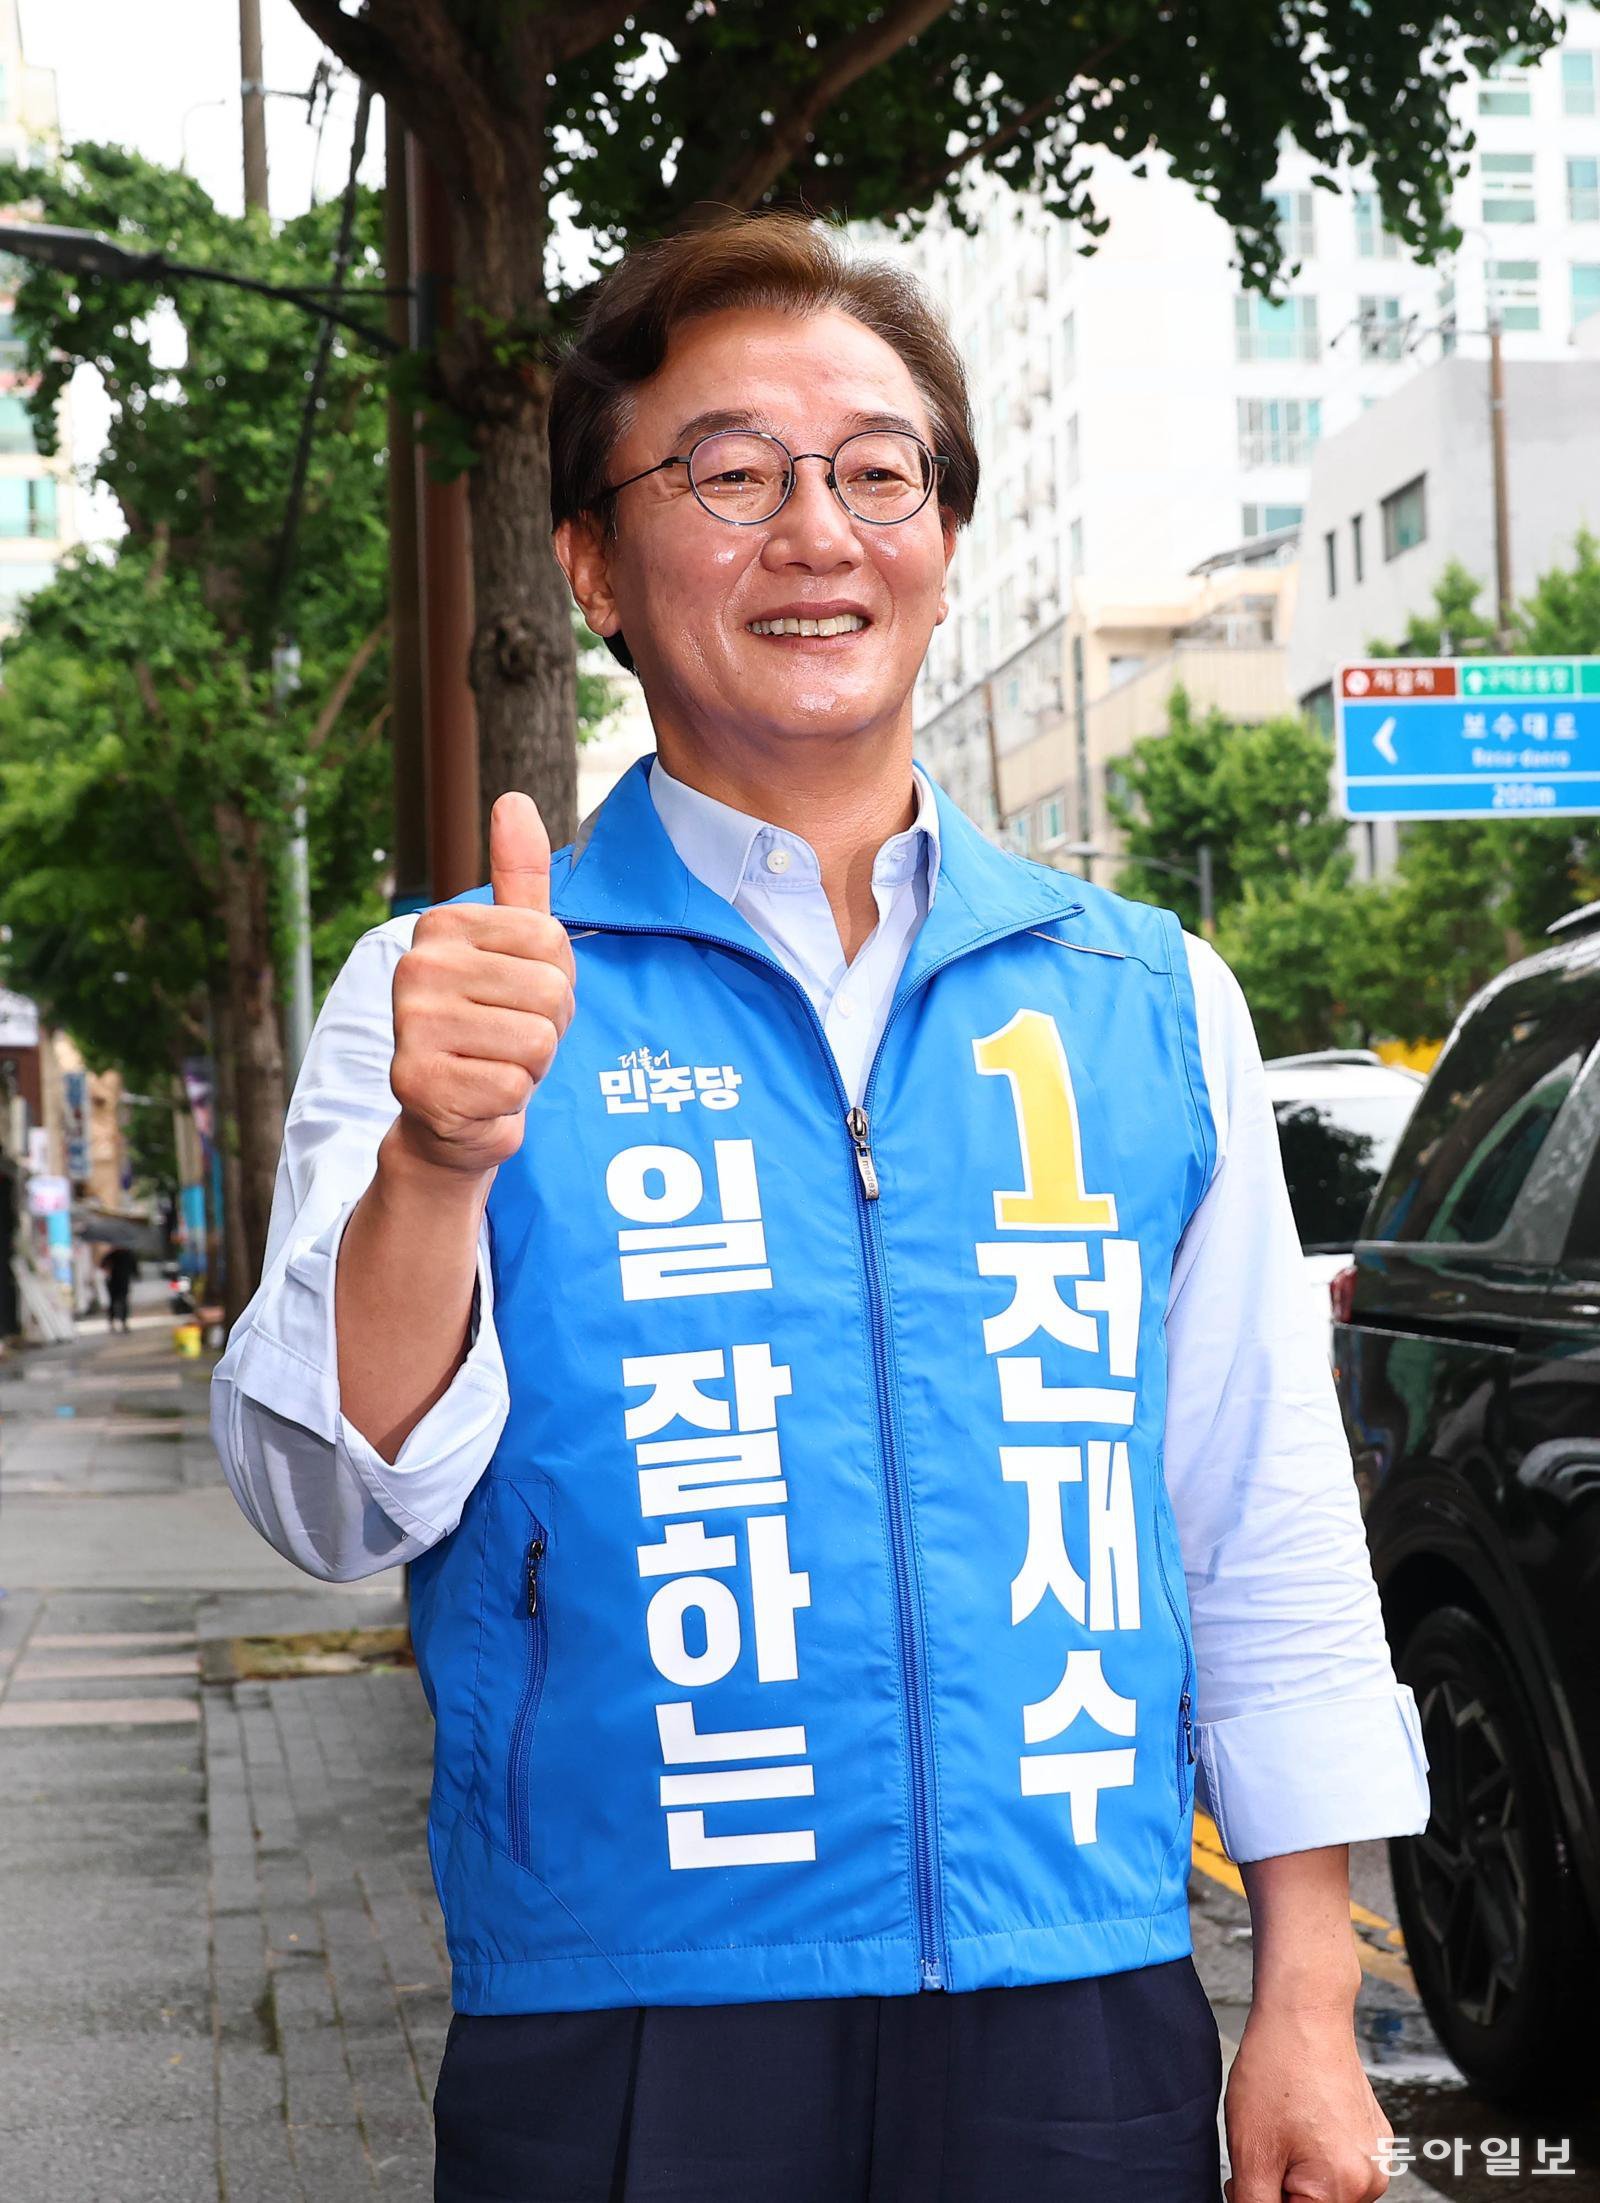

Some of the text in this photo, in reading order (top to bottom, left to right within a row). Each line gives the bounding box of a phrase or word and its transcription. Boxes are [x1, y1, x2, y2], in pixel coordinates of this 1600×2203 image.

[1461, 712, 1579, 741] 보수대로
[1491, 782, 1556, 808] 200m
[617, 1046, 671, 1073] 더불어
[598, 1066, 743, 1115] 민주당
[972, 1007, 1119, 1232] 1
[604, 1139, 817, 1871] 일 잘하는
[974, 1239, 1142, 1847] 전재수
